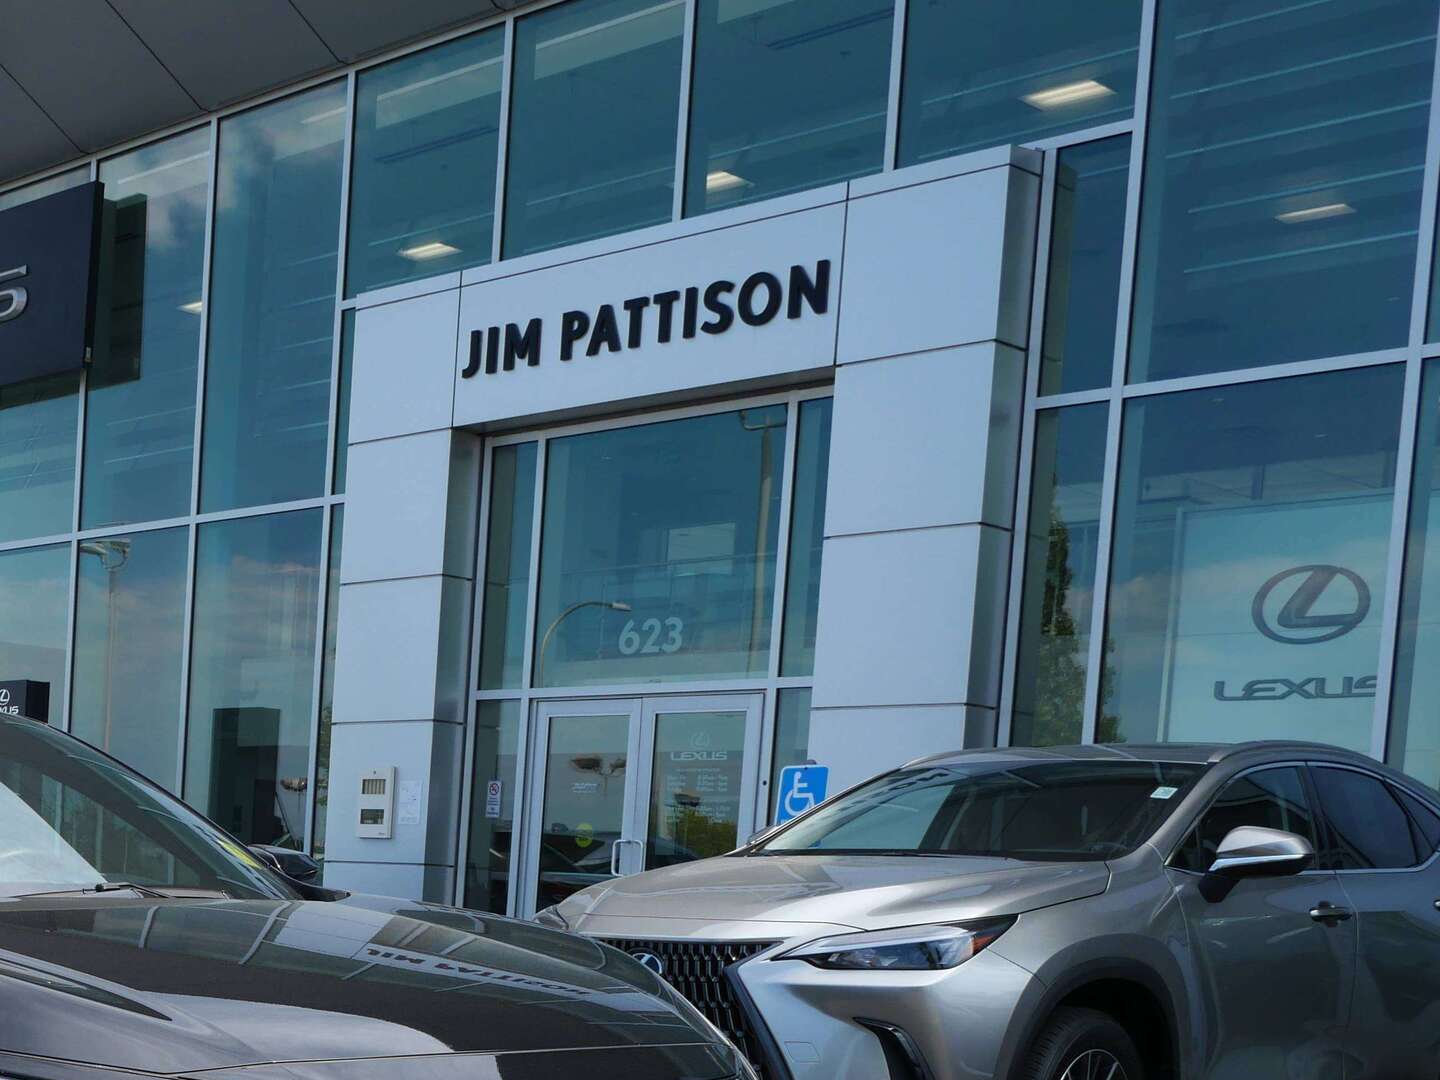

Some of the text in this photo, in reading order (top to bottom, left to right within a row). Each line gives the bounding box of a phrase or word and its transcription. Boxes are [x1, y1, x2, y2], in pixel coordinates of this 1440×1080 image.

[461, 258, 831, 379] JIM PATTISON
[618, 616, 683, 655] 623
[670, 751, 728, 761] LEXUS
